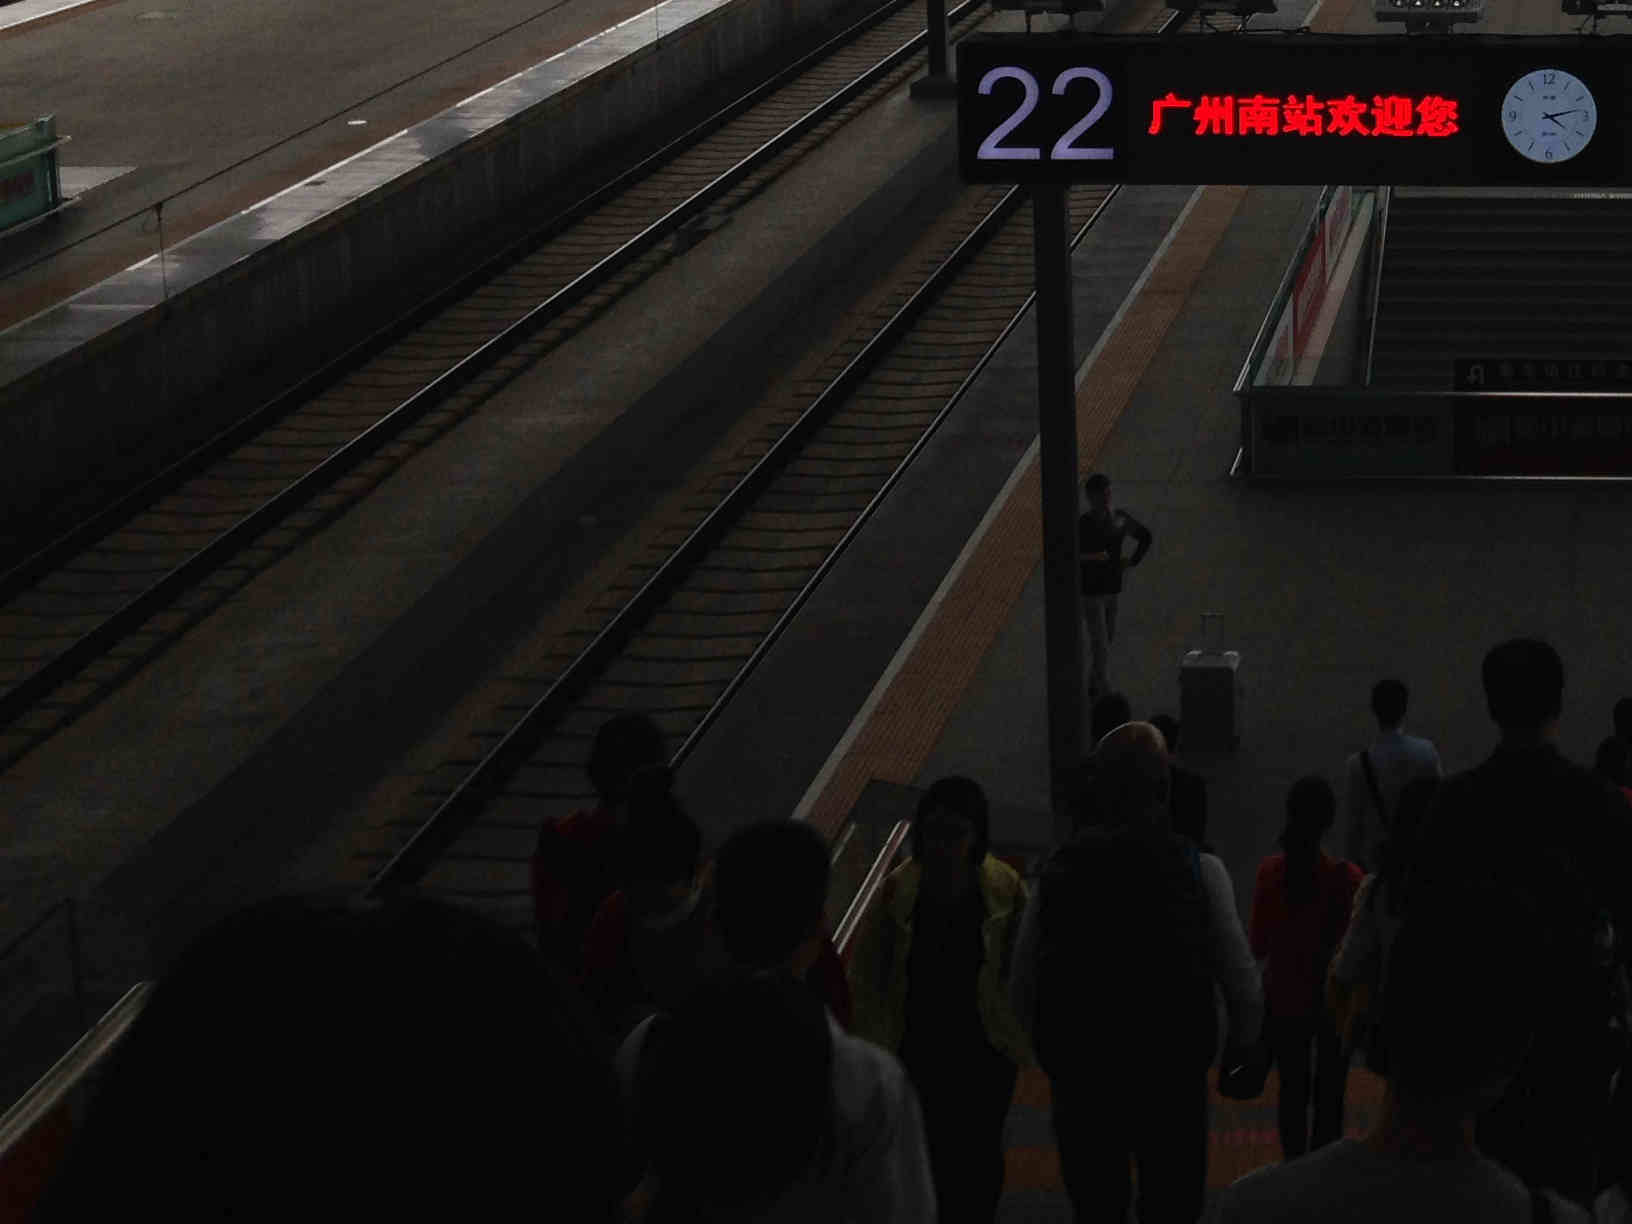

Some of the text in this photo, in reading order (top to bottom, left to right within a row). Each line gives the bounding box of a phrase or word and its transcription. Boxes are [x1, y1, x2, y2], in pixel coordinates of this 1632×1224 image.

[1542, 73, 1556, 85] 12
[978, 67, 1112, 159] 22
[1149, 93, 1459, 136] 广州南站欢迎您
[1508, 110, 1517, 122] 9
[1545, 147, 1553, 160] 6
